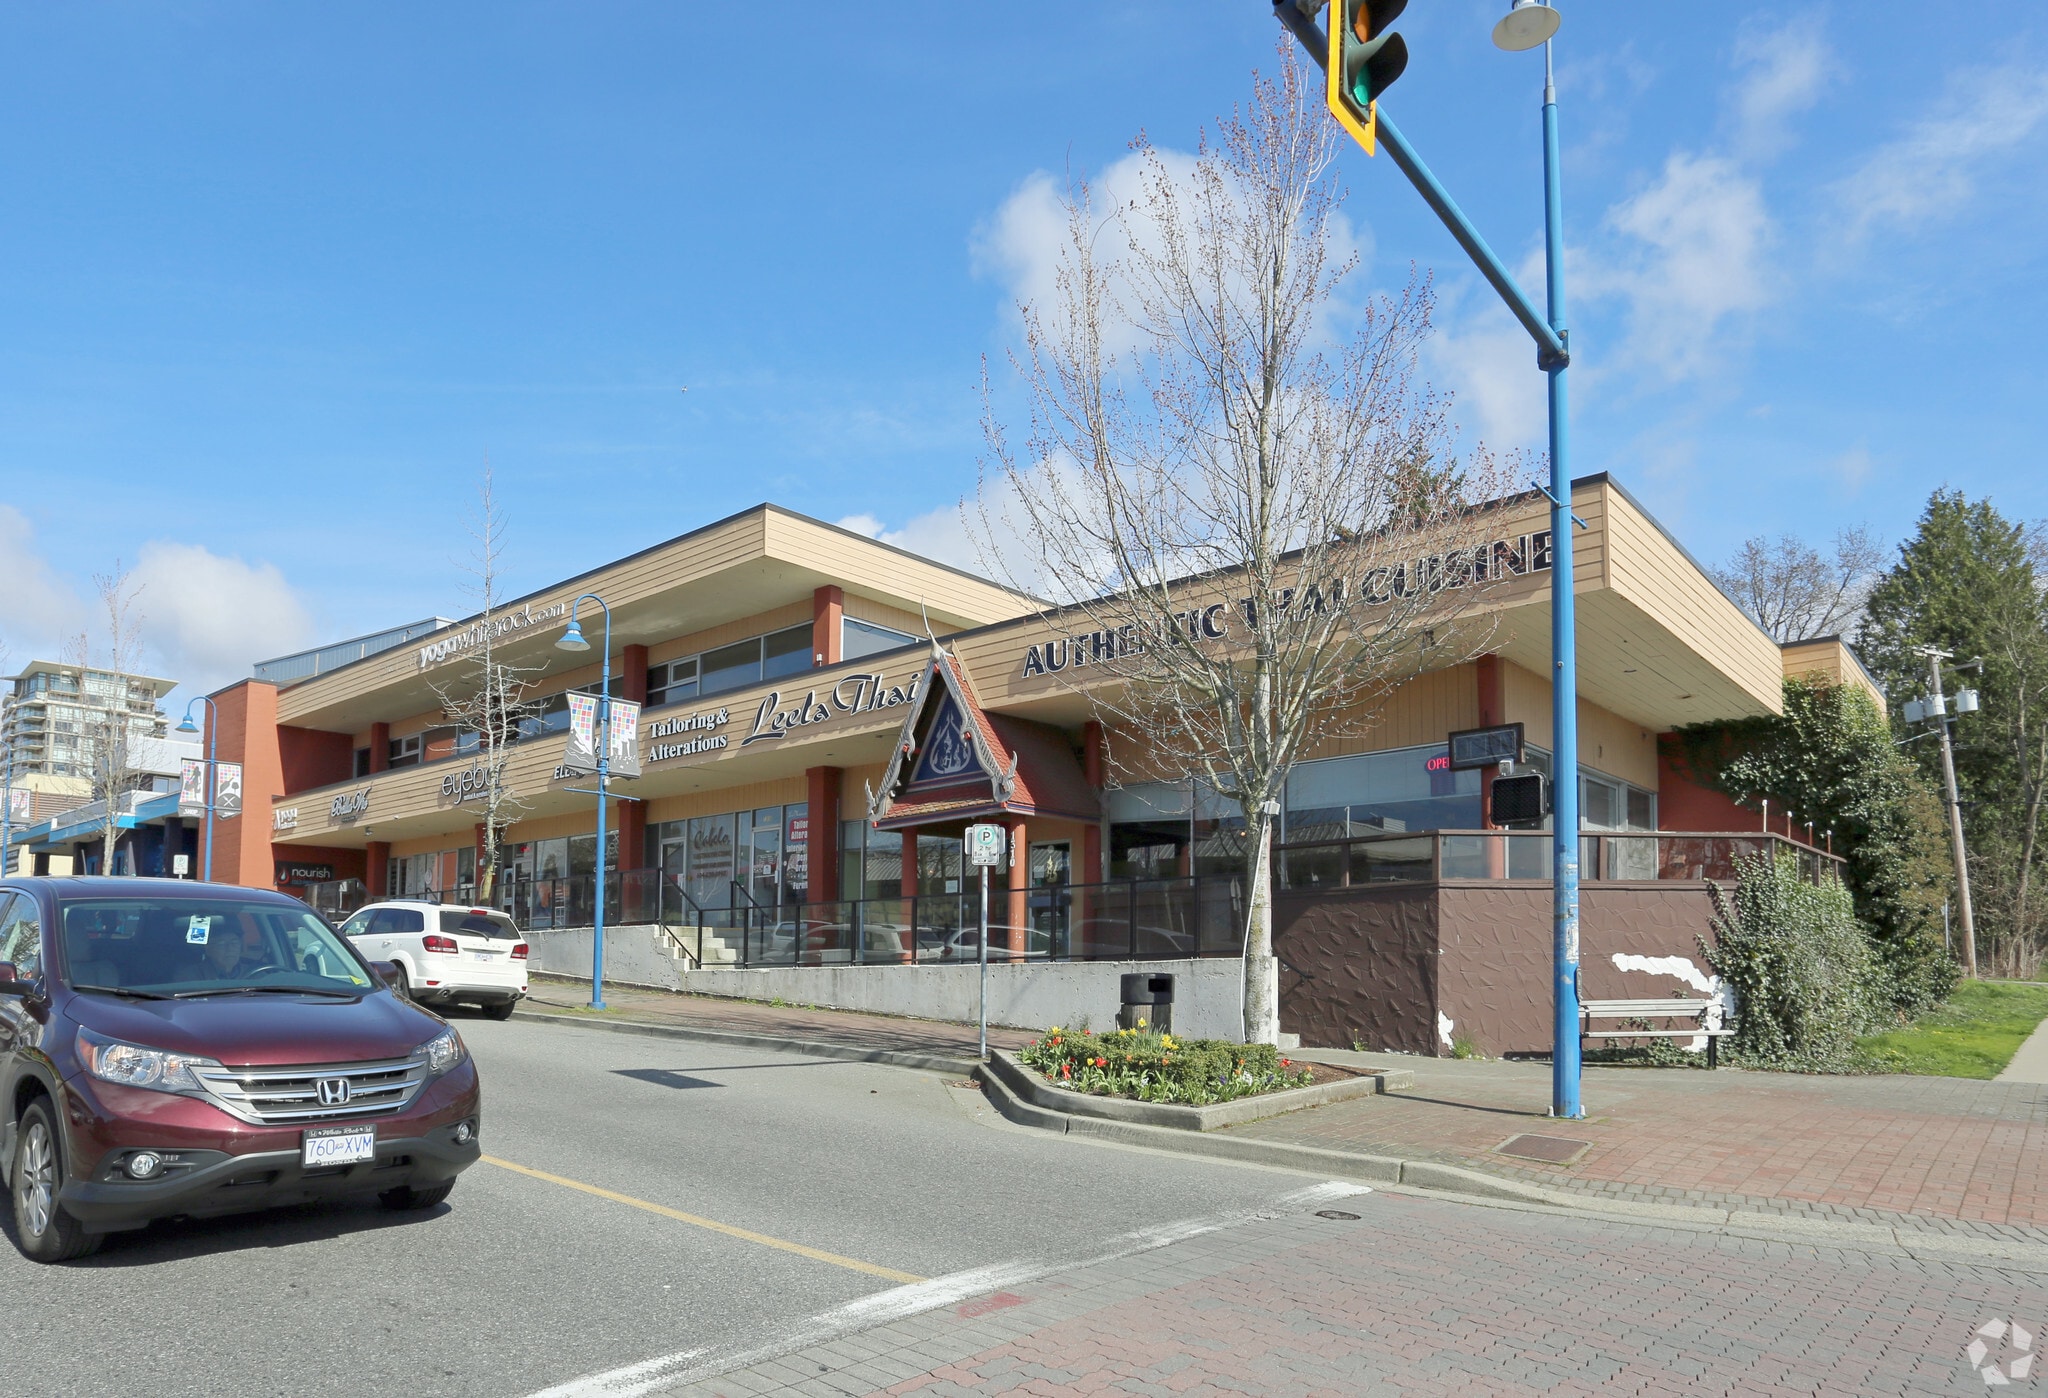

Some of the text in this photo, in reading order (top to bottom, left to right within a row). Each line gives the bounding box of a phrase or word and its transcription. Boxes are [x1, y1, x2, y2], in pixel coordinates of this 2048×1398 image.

[1361, 529, 1552, 606] CUISINE
[831, 673, 921, 716] Thai
[647, 735, 728, 763] Alterations
[1427, 756, 1451, 771] OPE
[291, 867, 331, 878] nourish
